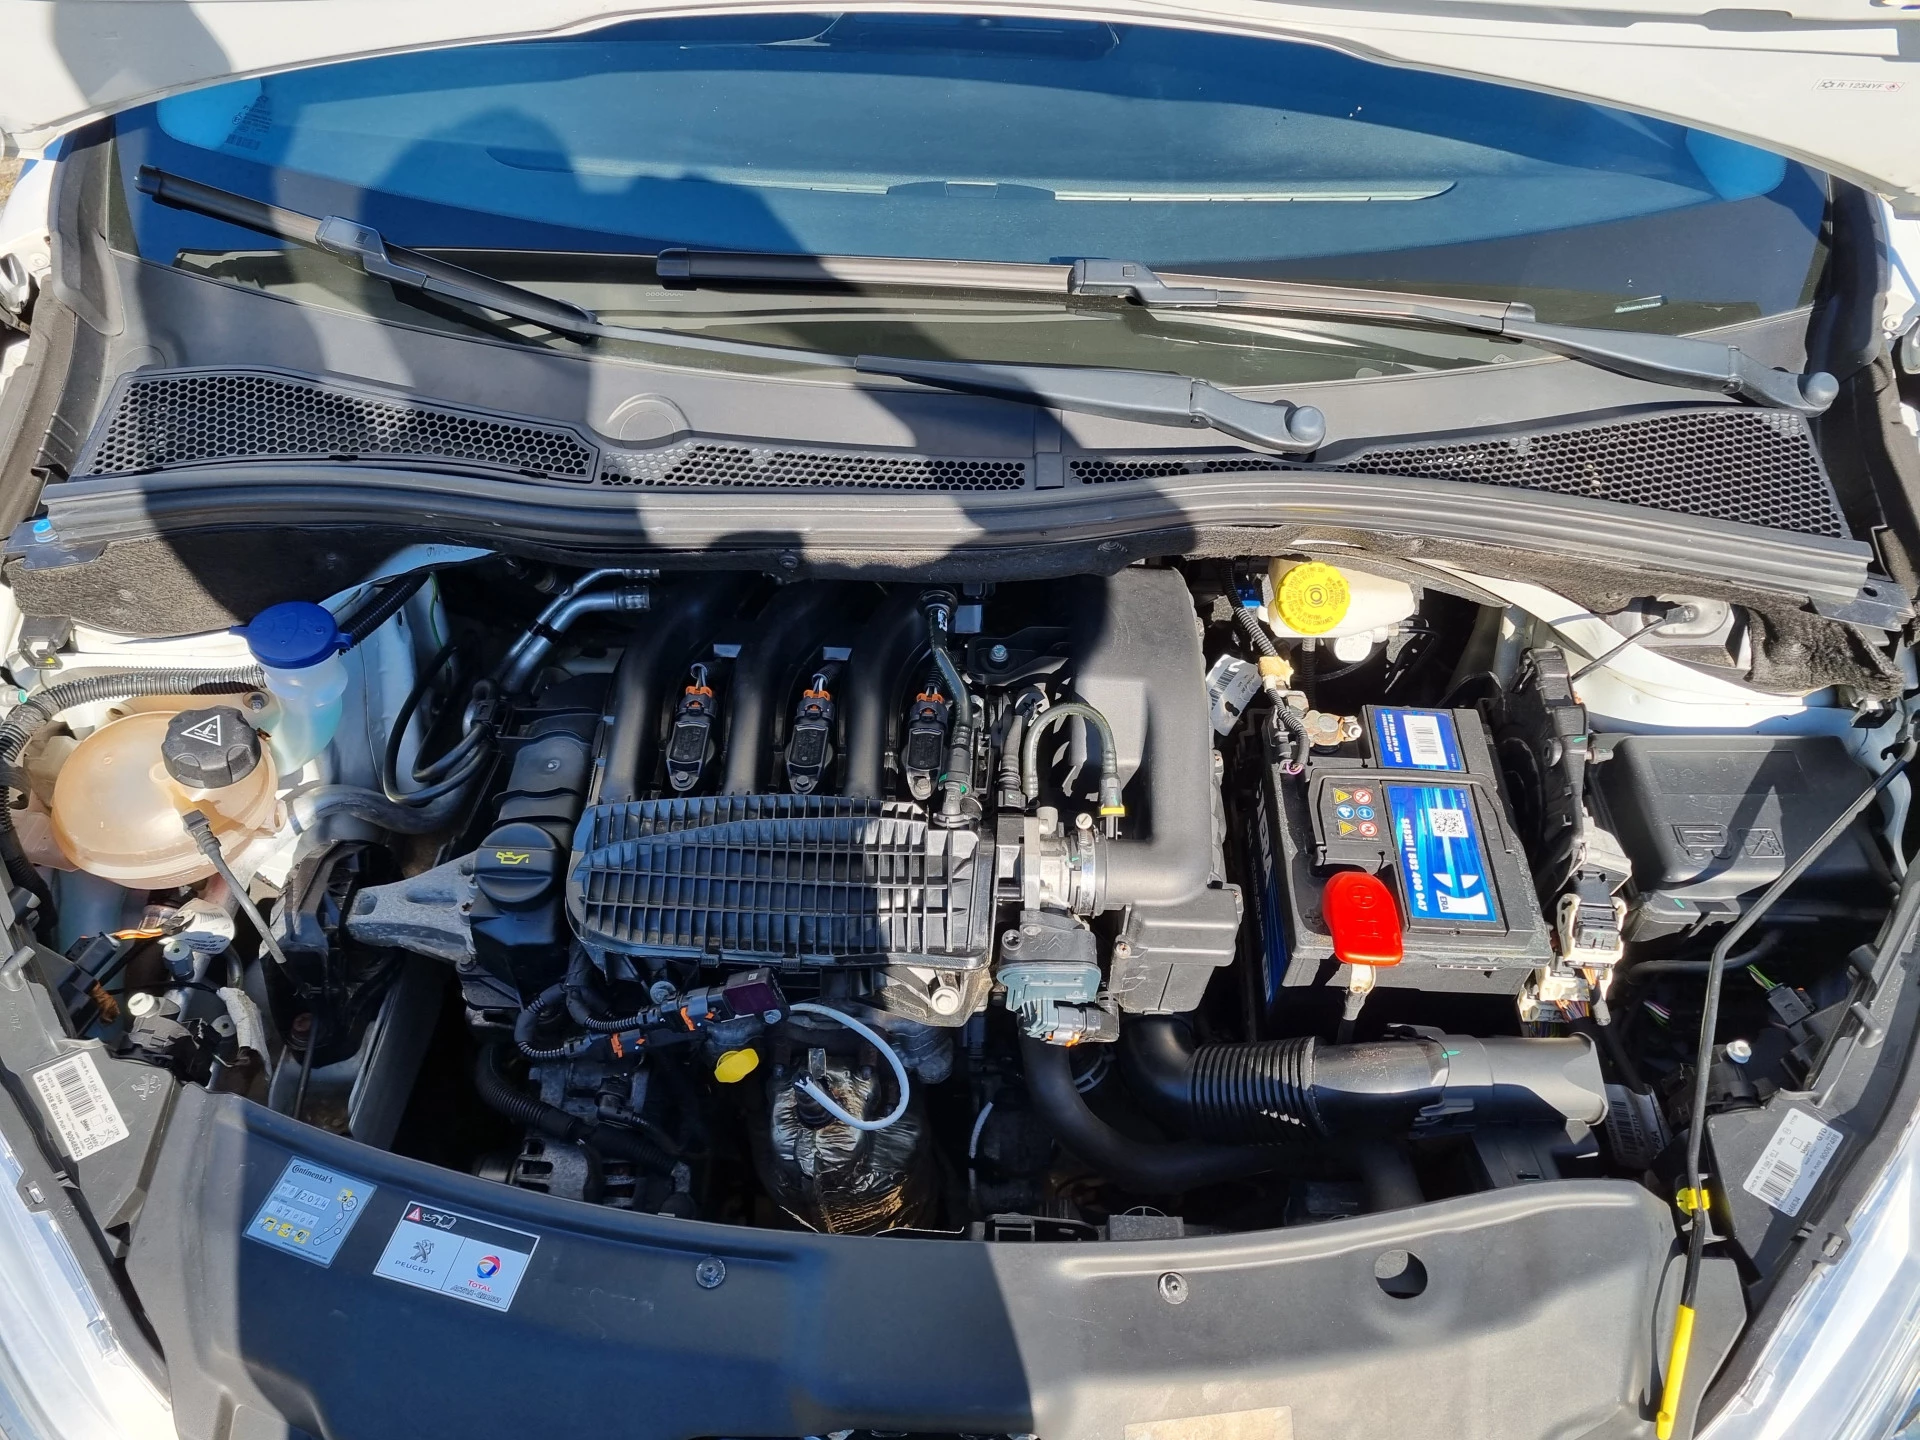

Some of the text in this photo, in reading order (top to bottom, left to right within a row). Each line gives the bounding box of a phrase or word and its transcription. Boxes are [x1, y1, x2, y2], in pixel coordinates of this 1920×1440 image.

[1412, 871, 1424, 892] 400
[1415, 893, 1428, 912] 047
[292, 1164, 329, 1182] Continental
[394, 1260, 436, 1275] PEUGEOT
[468, 1280, 492, 1292] TOTAL
